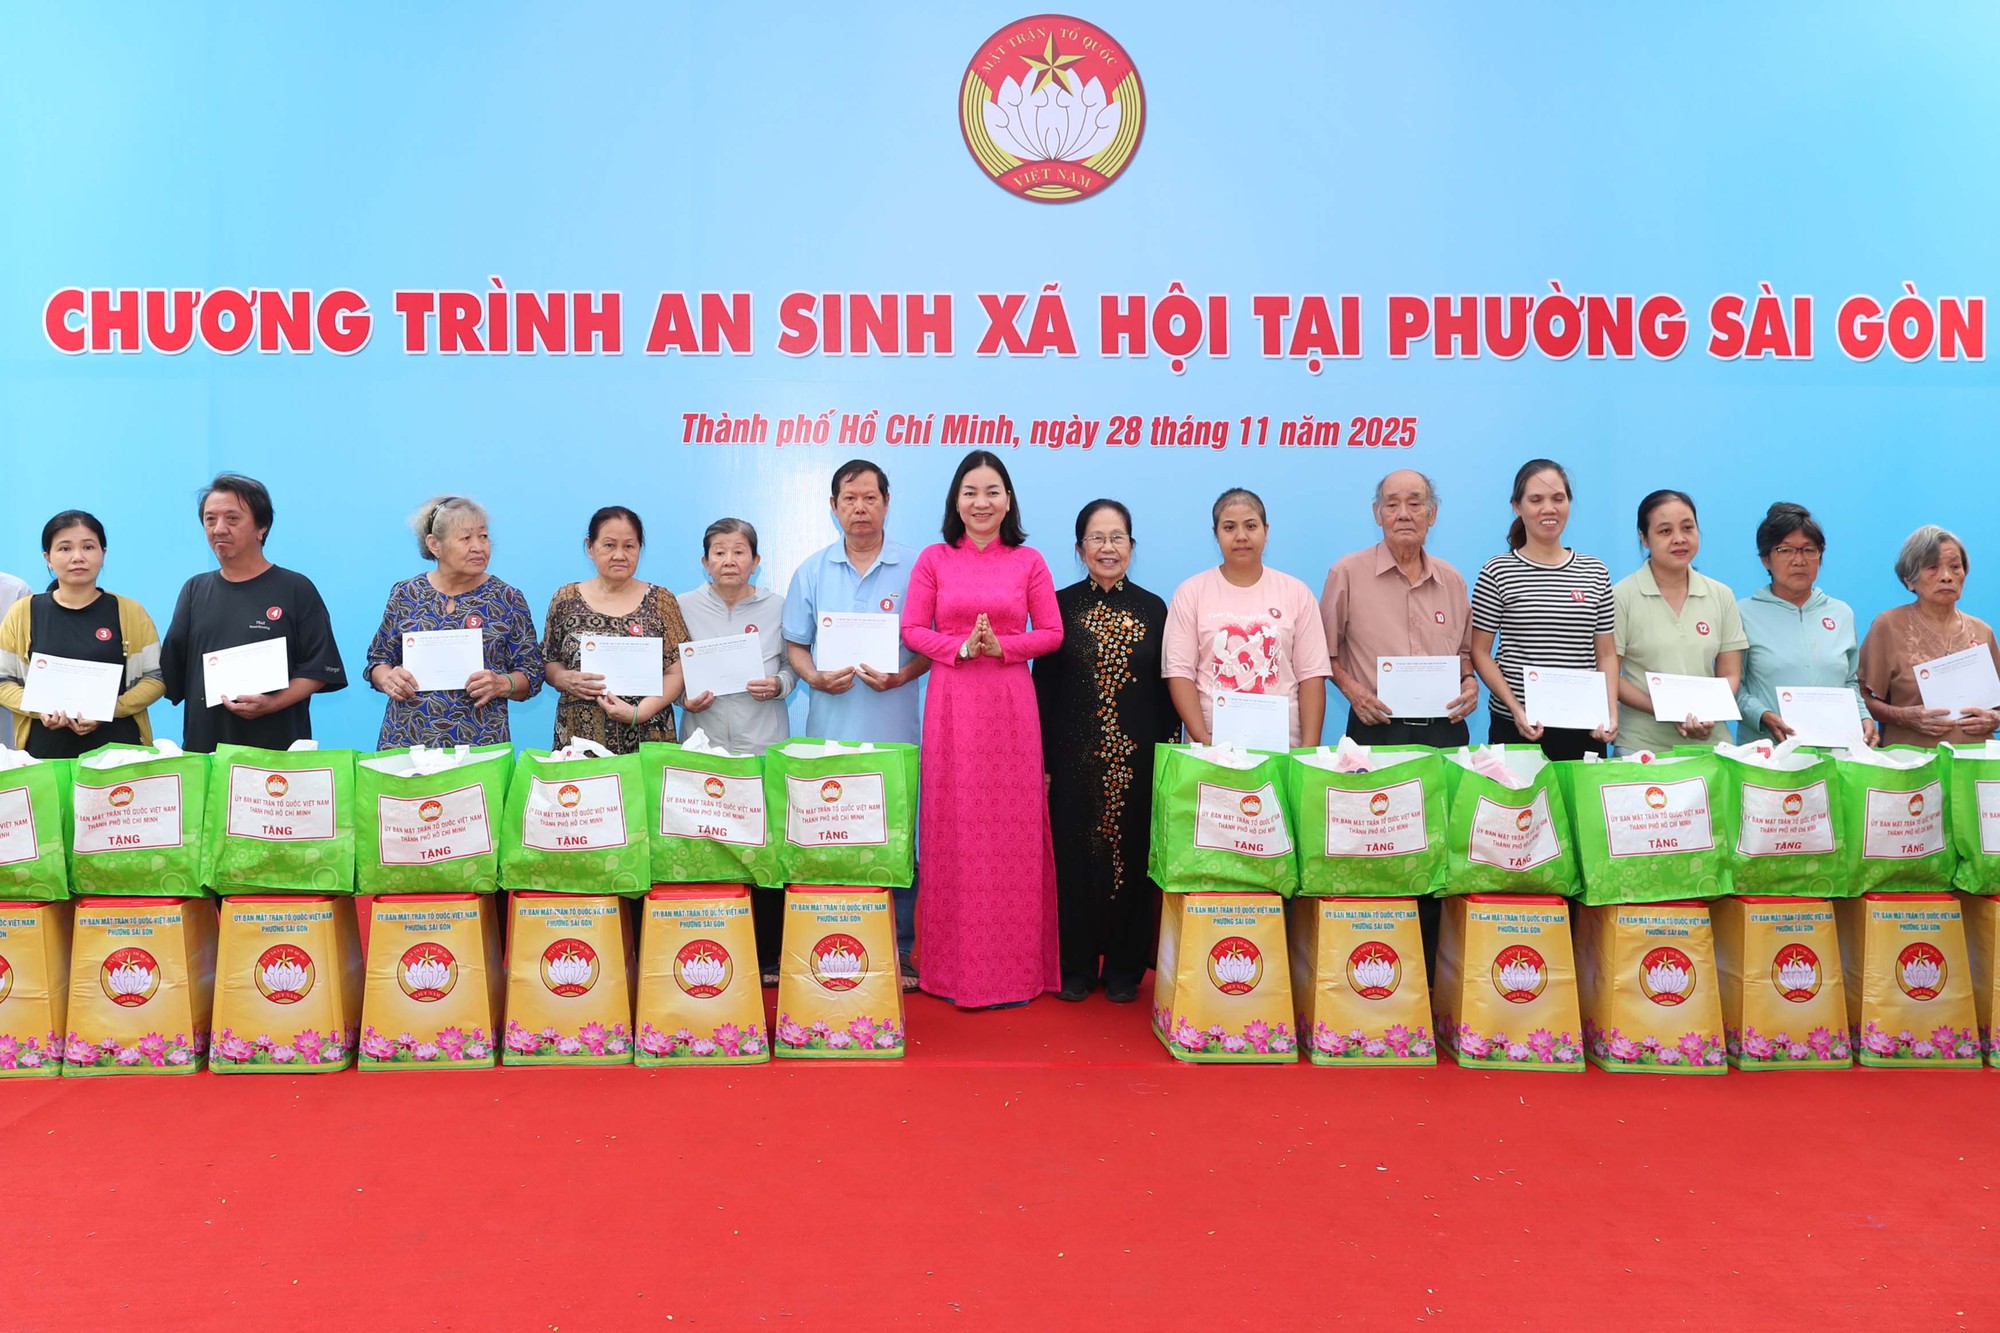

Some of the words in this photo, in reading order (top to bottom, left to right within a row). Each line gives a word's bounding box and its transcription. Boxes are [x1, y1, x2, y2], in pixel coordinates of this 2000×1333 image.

[981, 45, 1006, 73] MẶT
[1007, 27, 1047, 48] TRẬN
[1060, 26, 1079, 41] TỔ
[1082, 36, 1117, 66] QUỐC
[1013, 167, 1050, 187] VIỆT
[1056, 169, 1092, 188] NAM
[45, 288, 371, 353] CHƯƠNG
[396, 277, 621, 353] TRÌNH
[646, 293, 751, 353] AN
[778, 291, 953, 354] SINH
[977, 284, 1077, 354] XÃ
[1101, 282, 1228, 373] HỘI
[1253, 295, 1361, 373] TẠI
[1389, 281, 1687, 358] PHƯỜNG
[1709, 283, 1812, 358] SÀI
[1837, 283, 1984, 360] GÒN
[683, 413, 768, 443] Thành
[776, 409, 837, 447] phố
[840, 410, 880, 445] Hồ
[886, 413, 934, 445] Chí
[941, 414, 1020, 447] Minh,
[1030, 414, 1100, 449] ngày
[1106, 415, 1143, 446] 28
[1150, 415, 1229, 450] tháng
[1240, 416, 1269, 446] 11
[1279, 416, 1341, 446] năm
[1347, 416, 1417, 447] 2025
[1573, 591, 1583, 600] 11
[884, 600, 890, 609] 8
[271, 609, 279, 618] 4
[1436, 613, 1444, 623] 10
[471, 618, 477, 626] 5
[633, 625, 639, 633] 6
[750, 625, 756, 633] 7
[1698, 623, 1708, 633] 12
[101, 630, 107, 638] 3
[262, 825, 292, 837] TẶNG
[698, 825, 727, 836] TẶNG
[818, 830, 848, 842] TẶNG
[108, 834, 140, 847] TẶNG
[556, 836, 588, 847] TẶNG
[1234, 840, 1264, 852] TẶNG
[1648, 838, 1678, 850] TẶNG
[1366, 842, 1394, 853] TẶNG
[1775, 842, 1802, 852] TẶNG
[1902, 843, 1924, 855] TẶNG
[420, 846, 451, 860] TẶNG
[1509, 854, 1532, 868] TẶNG
